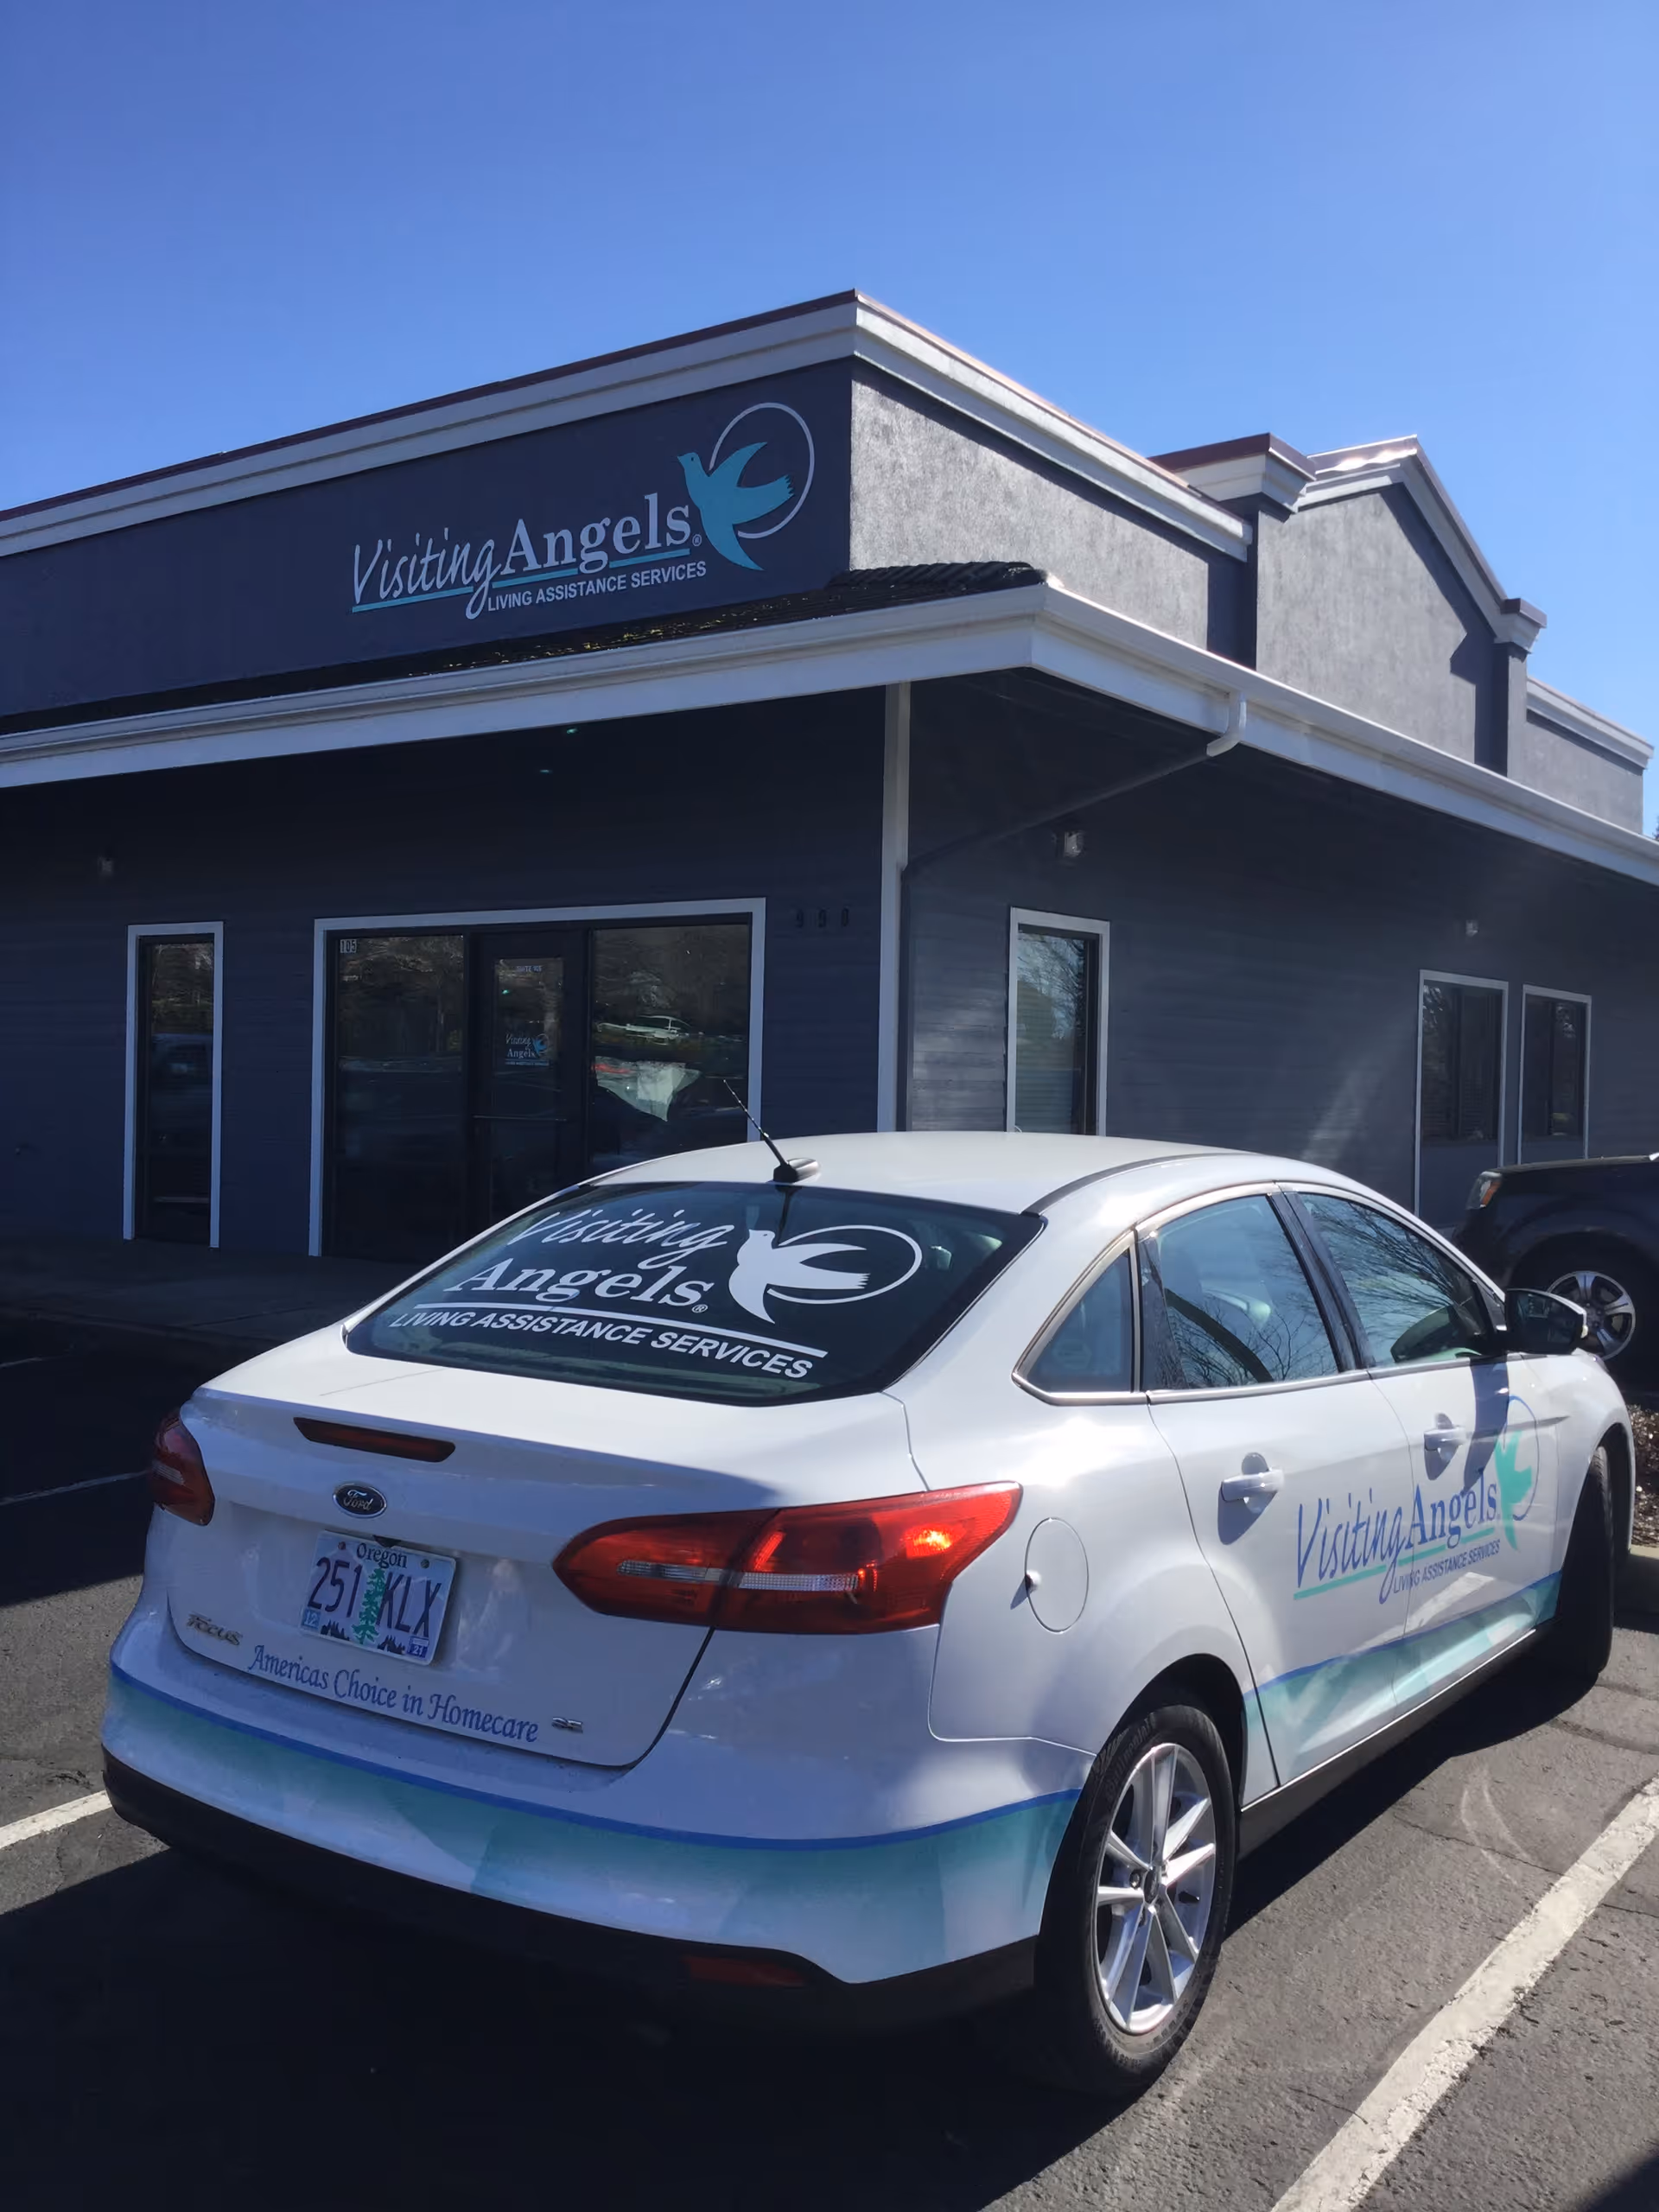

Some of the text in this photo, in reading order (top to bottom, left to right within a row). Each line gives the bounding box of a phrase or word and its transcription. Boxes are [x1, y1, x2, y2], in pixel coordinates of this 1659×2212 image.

[353, 528, 501, 620] Visiting
[487, 560, 707, 612] LIVING ASSISTANCE SERVICES
[508, 1210, 734, 1269] Visiting
[389, 1310, 814, 1379] LIVING ASSISTANCE SERVICES
[344, 1489, 373, 1511] Ford
[356, 1542, 407, 1569] Oregon
[1297, 1487, 1407, 1605] Visiting
[1393, 1539, 1501, 1594] LIVING ASSISTANCE SERVICES
[303, 1611, 317, 1627] 12
[308, 1557, 442, 1638] 251 KLX
[413, 1644, 424, 1657] 21
[247, 1644, 538, 1742] Americas Choice in Homecare
